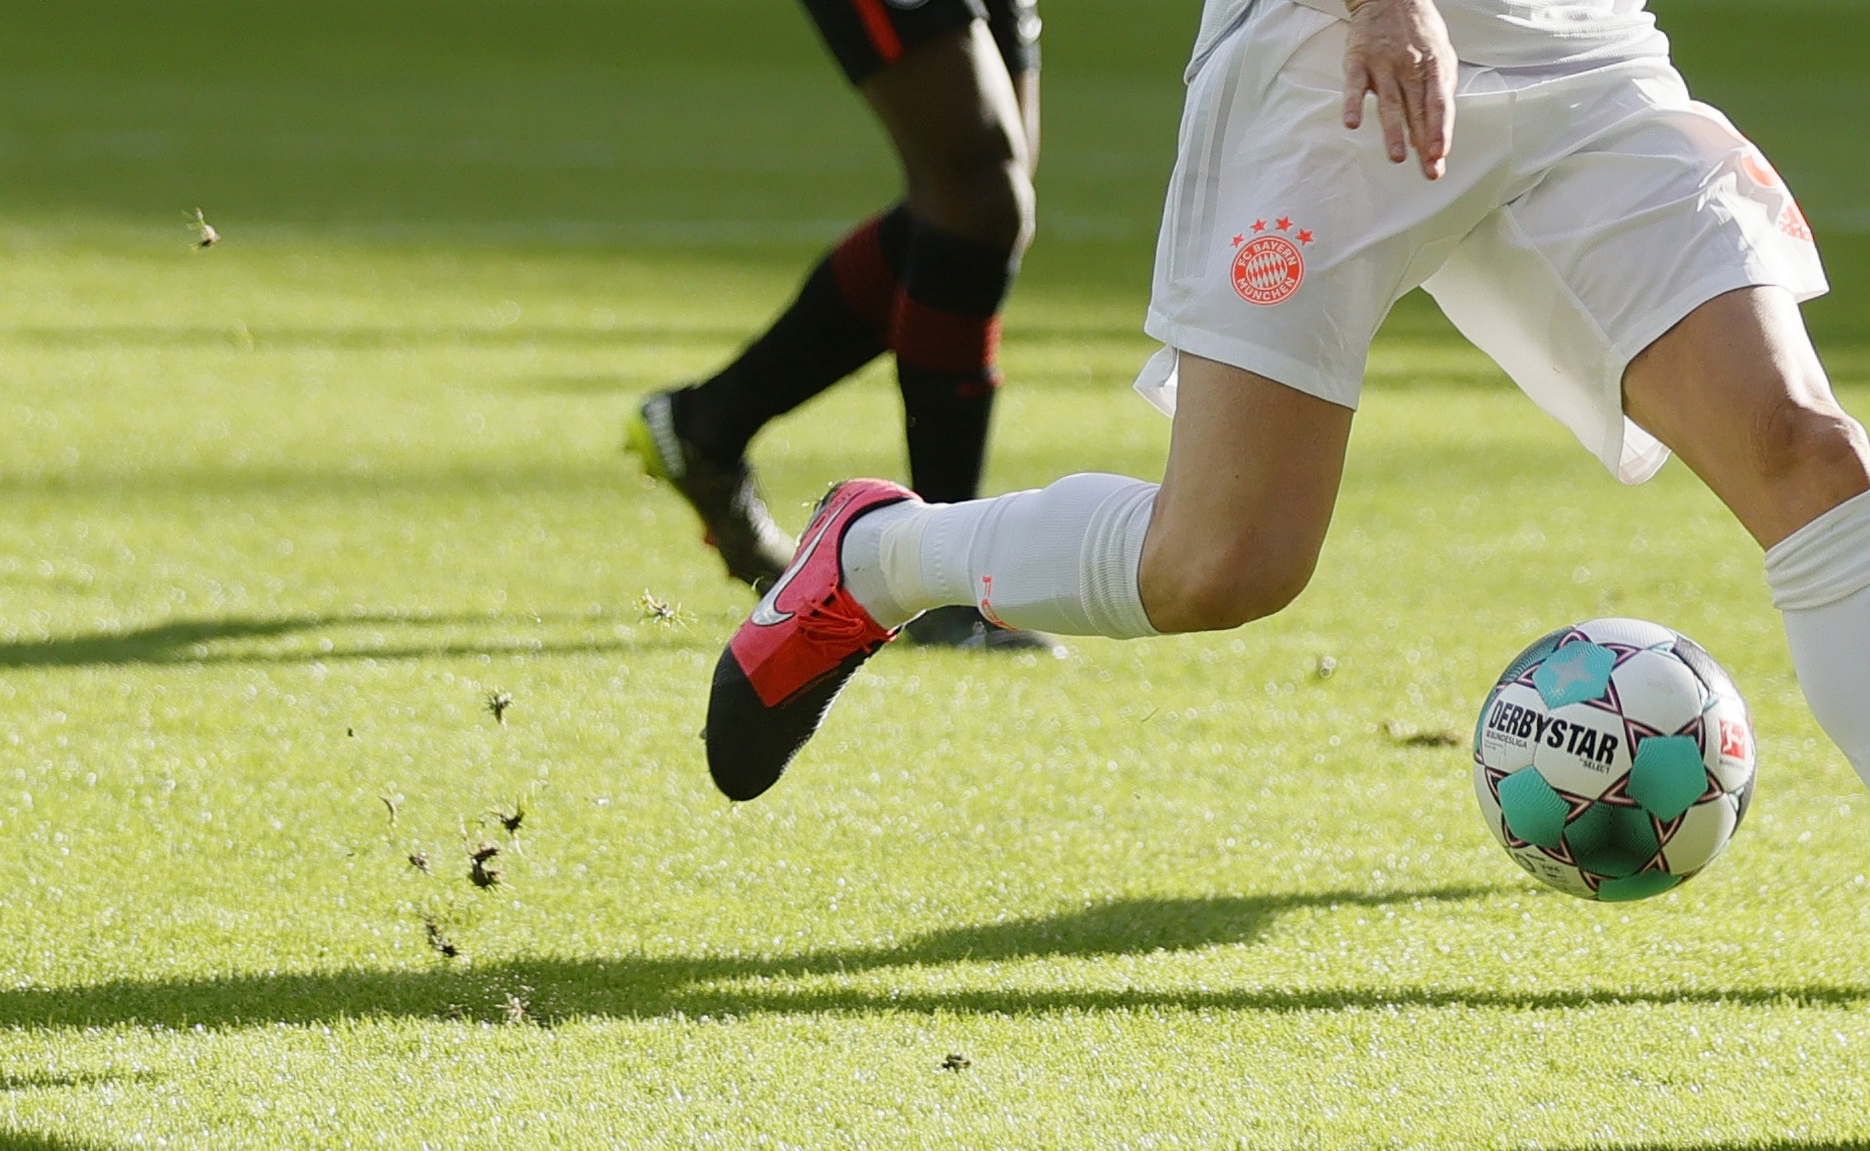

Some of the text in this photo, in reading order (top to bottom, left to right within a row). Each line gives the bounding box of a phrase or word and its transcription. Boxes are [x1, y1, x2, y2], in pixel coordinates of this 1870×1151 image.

[1237, 241, 1298, 267] FC BAYERN
[1488, 700, 1619, 766] DERBYSTAR
[1490, 730, 1528, 749] BUNDESLIGA
